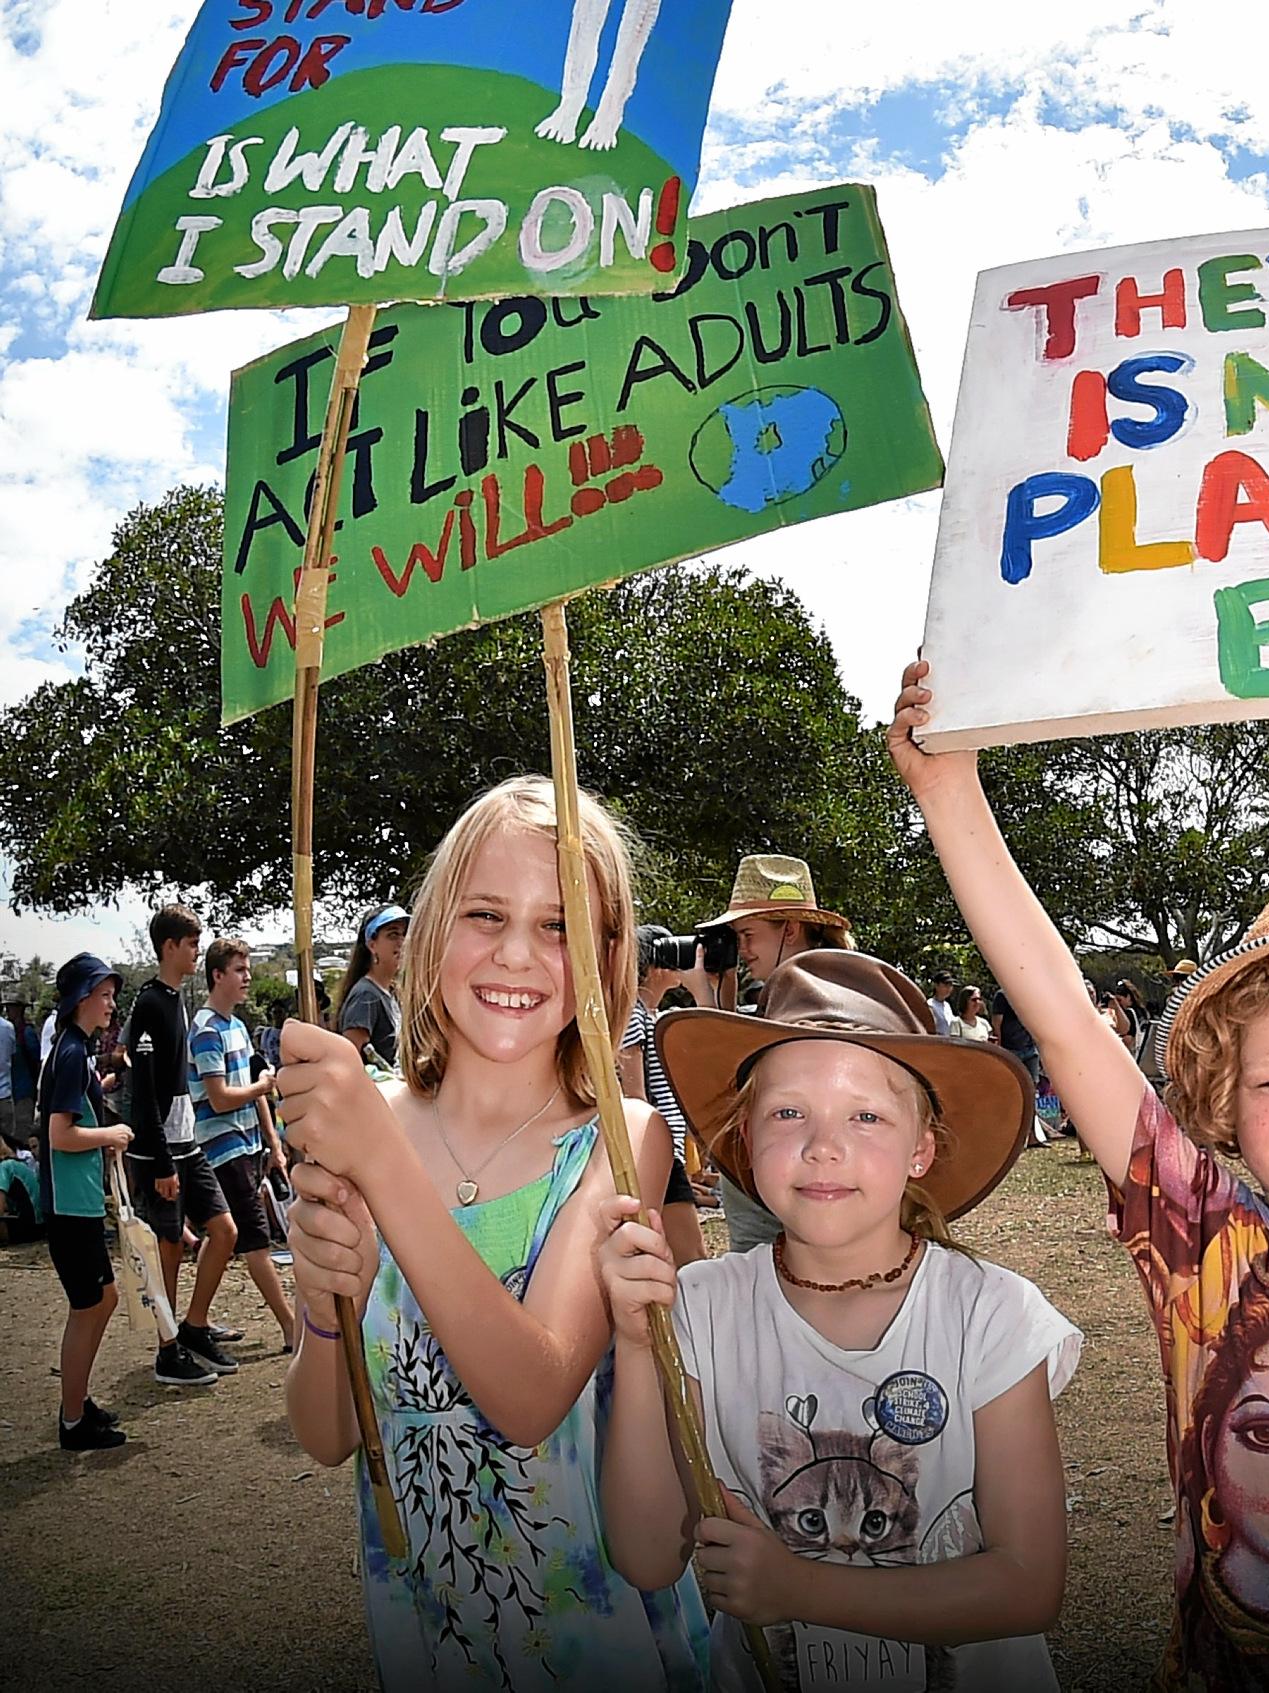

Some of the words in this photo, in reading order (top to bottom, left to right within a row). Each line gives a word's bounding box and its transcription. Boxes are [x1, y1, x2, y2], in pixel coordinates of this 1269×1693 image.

[209, 35, 352, 98] FOR
[188, 134, 263, 198] IS
[263, 119, 508, 201] WHAT
[156, 214, 223, 285] I
[233, 199, 508, 281] STAND
[519, 175, 681, 274] ON!
[616, 261, 892, 411] ADULTS
[1065, 350, 1196, 461] IS
[895, 1377, 917, 1388] JOIN
